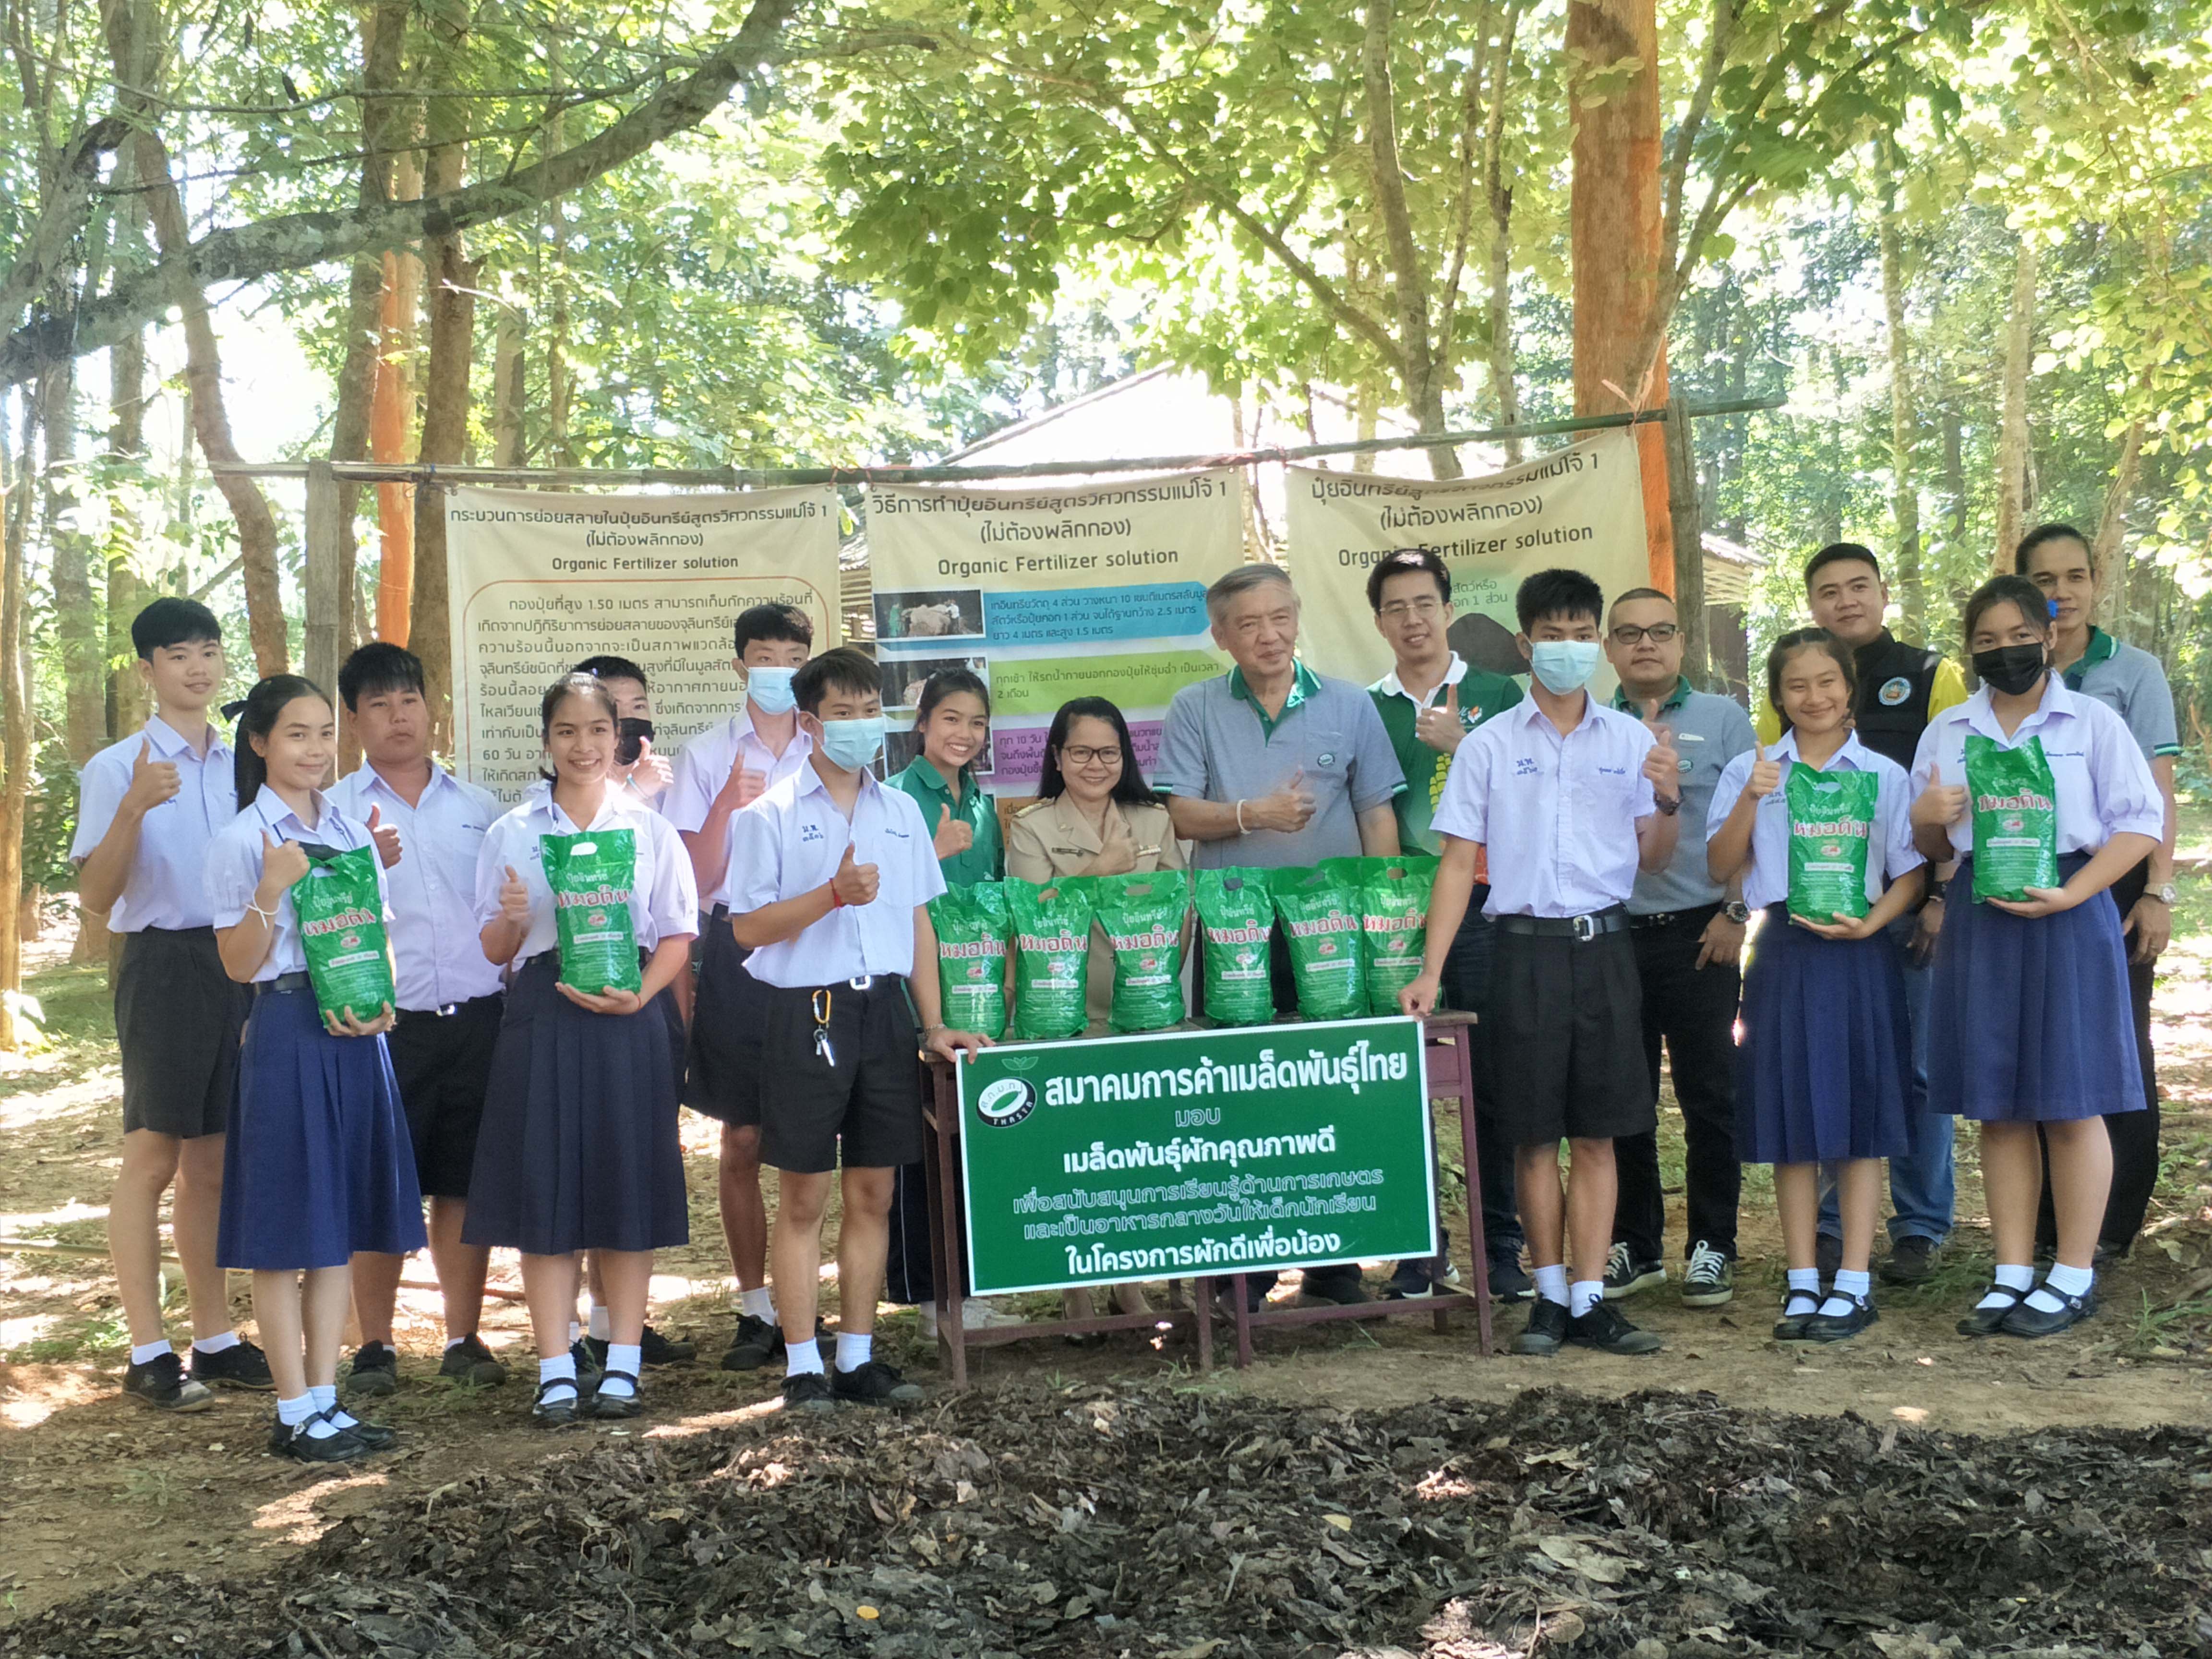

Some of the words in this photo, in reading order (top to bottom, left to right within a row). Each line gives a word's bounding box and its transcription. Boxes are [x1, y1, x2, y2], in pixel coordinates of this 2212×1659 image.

[1590, 453, 1598, 469] 1
[1219, 481, 1226, 496] 1
[821, 505, 827, 517] 1
[1380, 495, 1542, 530] (ไม่ต้องพลิกกอง)
[587, 530, 703, 547] (ไม่ต้องพลิกกอง)
[981, 518, 1131, 543] (ไม่ต้องพลิกกอง)
[1338, 545, 1397, 568] Organ
[1515, 526, 1593, 549] solution
[553, 557, 607, 572] Organic
[614, 557, 677, 570] Fertilizer
[683, 557, 738, 569] solution
[938, 557, 1008, 577] Organic
[1016, 554, 1098, 572] Fertilizer
[1106, 550, 1178, 566] solution
[509, 594, 582, 614] กองปุ๋ยที่สูง
[589, 599, 613, 610] 1.50
[619, 599, 649, 609] เมตร
[1121, 595, 1130, 603] 10
[1451, 598, 1469, 607] อก
[1472, 595, 1479, 605] 1
[1157, 607, 1172, 616] 2.5
[1077, 627, 1088, 636] 1.5
[479, 637, 736, 653] ความร้อนนี้นอกจากจะเป็นสภาพแวดล้อ
[480, 680, 546, 696] ร้อนนี้ลอย
[997, 690, 1003, 699] 2
[655, 699, 744, 715] ซึ่งเกิดจากการ
[483, 749, 499, 760] 60
[505, 748, 521, 760] วัน
[1045, 1039, 1407, 1106] สมาคมการค้าเมล็ดพันธุ์ไทย
[993, 1101, 1033, 1126] THASTA
[1175, 1107, 1221, 1127] มอบ
[1064, 1125, 1336, 1173] เมล็ดพันธุ์ผักคุณภาพดี
[1013, 1168, 1383, 1214] เพื่อสนับสนุนการเรียนรู้ด้านการเกษตร
[1024, 1192, 1376, 1240] และเป็นอาหารกลางวันให้เด็กนักเรียน
[1065, 1225, 1341, 1274] ในโครงการผักดีเพื่อน้อง
